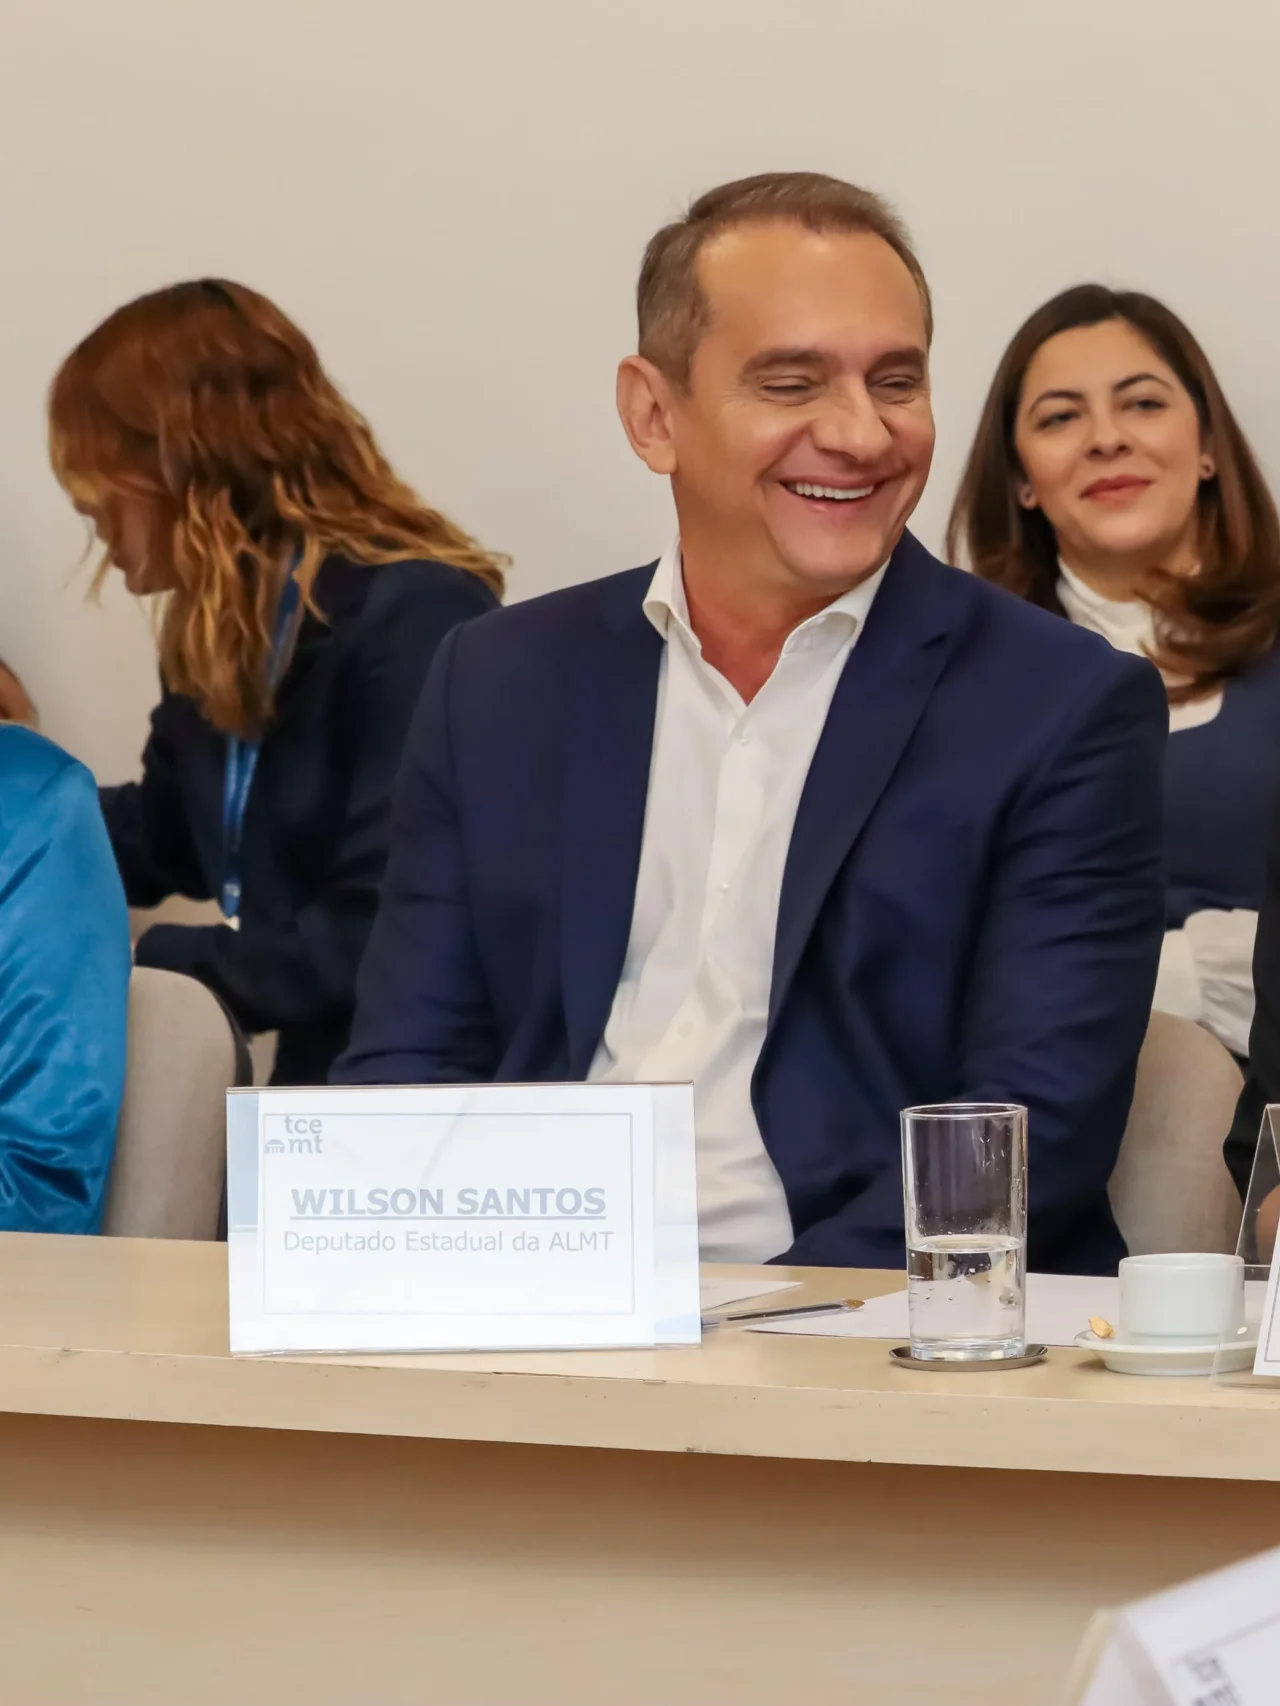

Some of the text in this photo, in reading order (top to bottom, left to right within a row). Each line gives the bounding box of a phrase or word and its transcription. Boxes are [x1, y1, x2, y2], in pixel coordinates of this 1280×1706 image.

[284, 1115, 323, 1134] tce
[288, 1135, 323, 1154] mt
[290, 1187, 607, 1216] WILSON SANTOS
[283, 1230, 615, 1256] Deputado Estadual da ALMT
